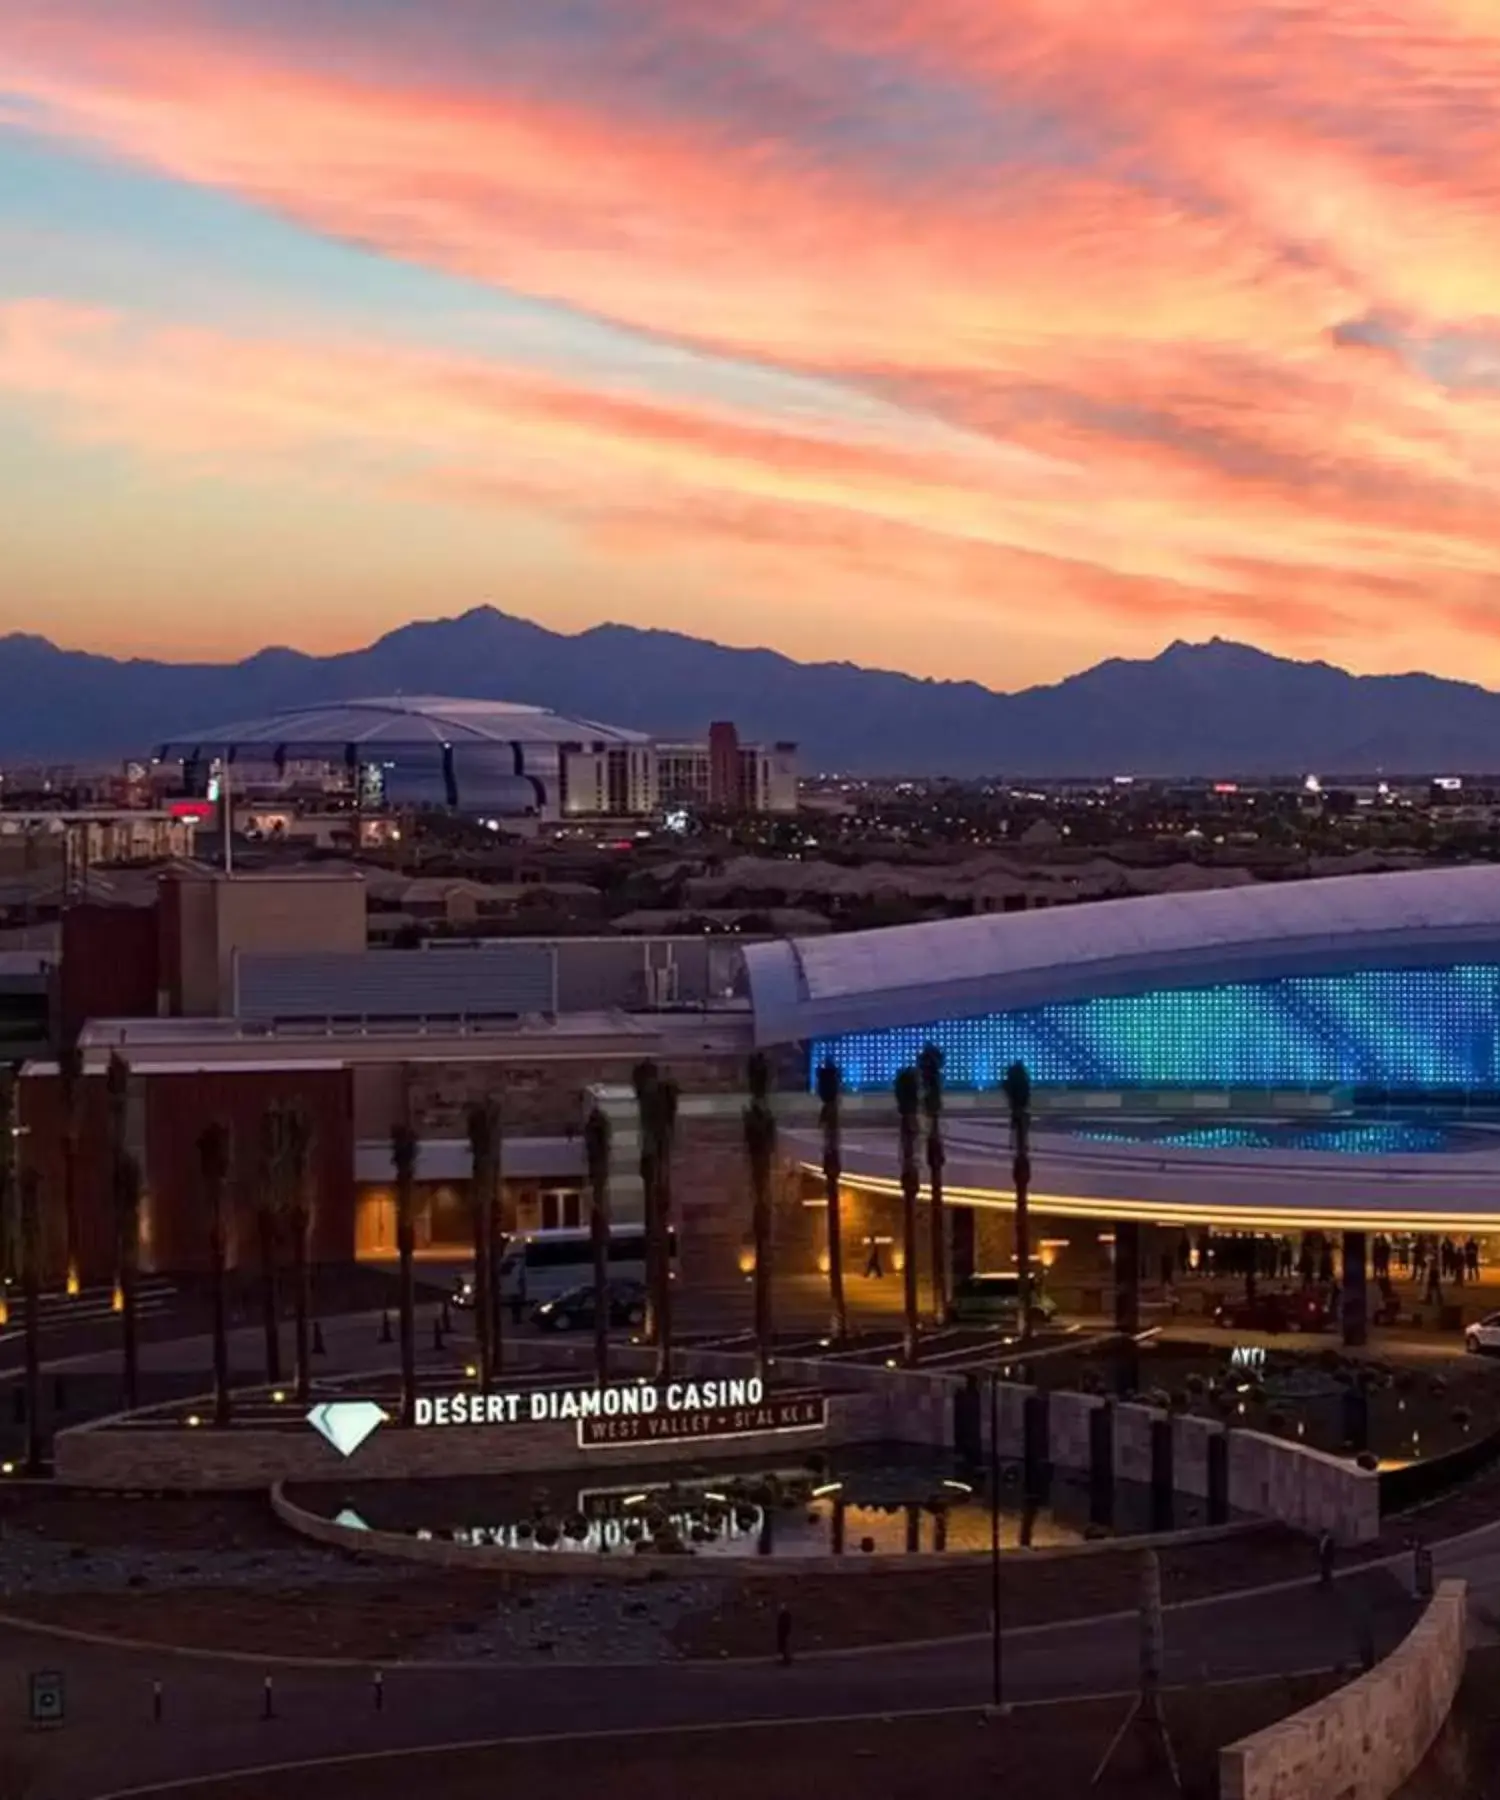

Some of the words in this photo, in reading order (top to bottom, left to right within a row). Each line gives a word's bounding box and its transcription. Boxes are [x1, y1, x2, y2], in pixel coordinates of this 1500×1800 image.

[414, 1393, 520, 1425] DESERT
[530, 1386, 659, 1420] DIAMOND
[665, 1377, 763, 1411] CASINO
[591, 1420, 641, 1440] WEST
[648, 1413, 711, 1437] VALLEY
